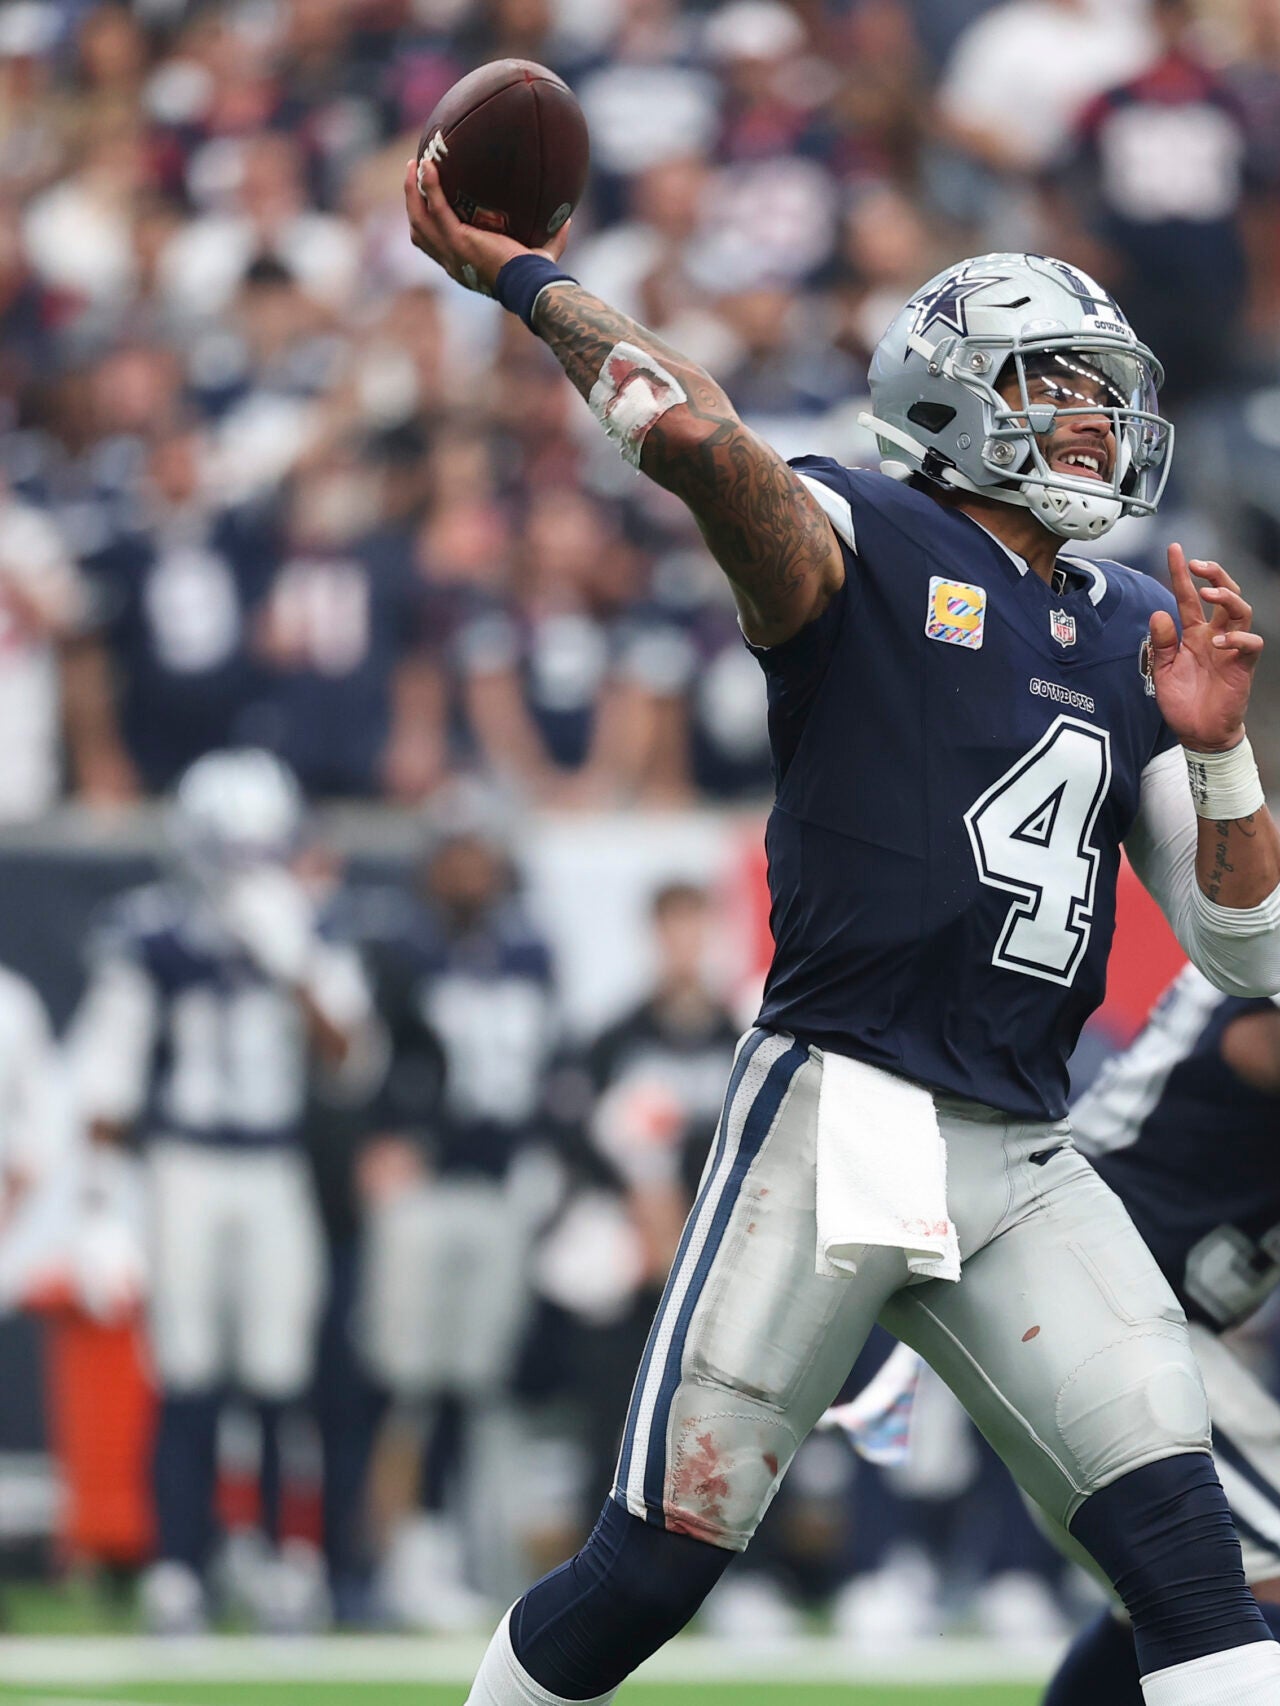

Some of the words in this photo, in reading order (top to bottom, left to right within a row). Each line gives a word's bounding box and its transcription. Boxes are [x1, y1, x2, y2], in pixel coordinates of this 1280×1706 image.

[934, 583, 983, 632] C
[1055, 623, 1074, 641] NFL
[1029, 677, 1095, 714] COWBOYS
[962, 713, 1113, 989] 4
